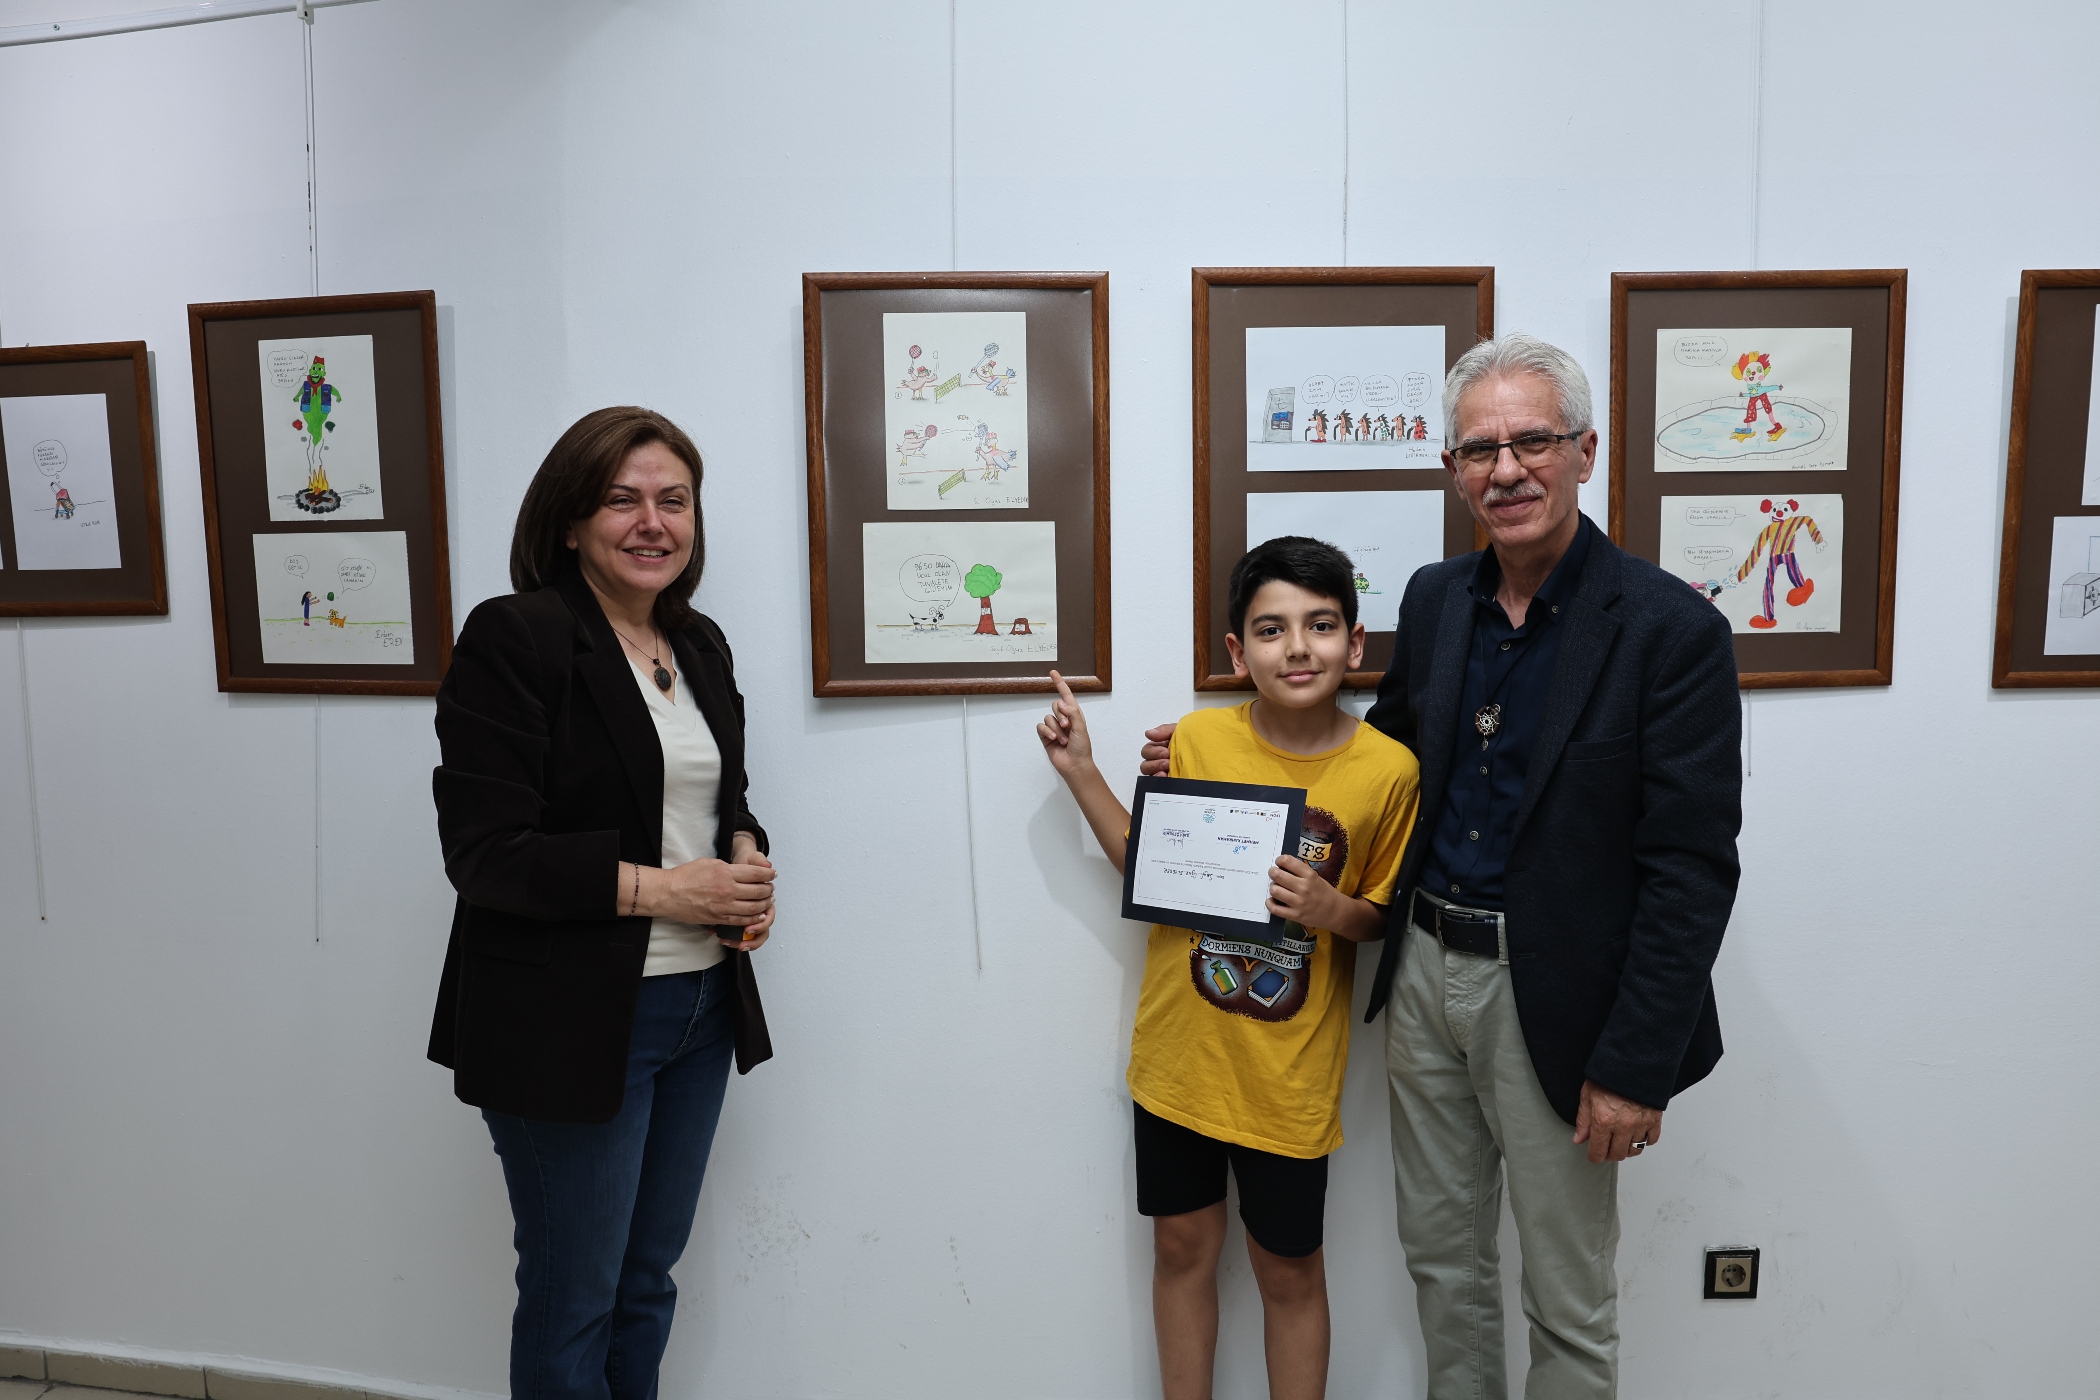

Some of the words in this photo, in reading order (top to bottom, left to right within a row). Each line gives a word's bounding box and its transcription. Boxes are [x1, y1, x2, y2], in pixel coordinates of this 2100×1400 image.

[1301, 842, 1326, 860] TS
[1201, 938, 1252, 954] DORMIENS
[1253, 948, 1302, 967] NUNQUAM
